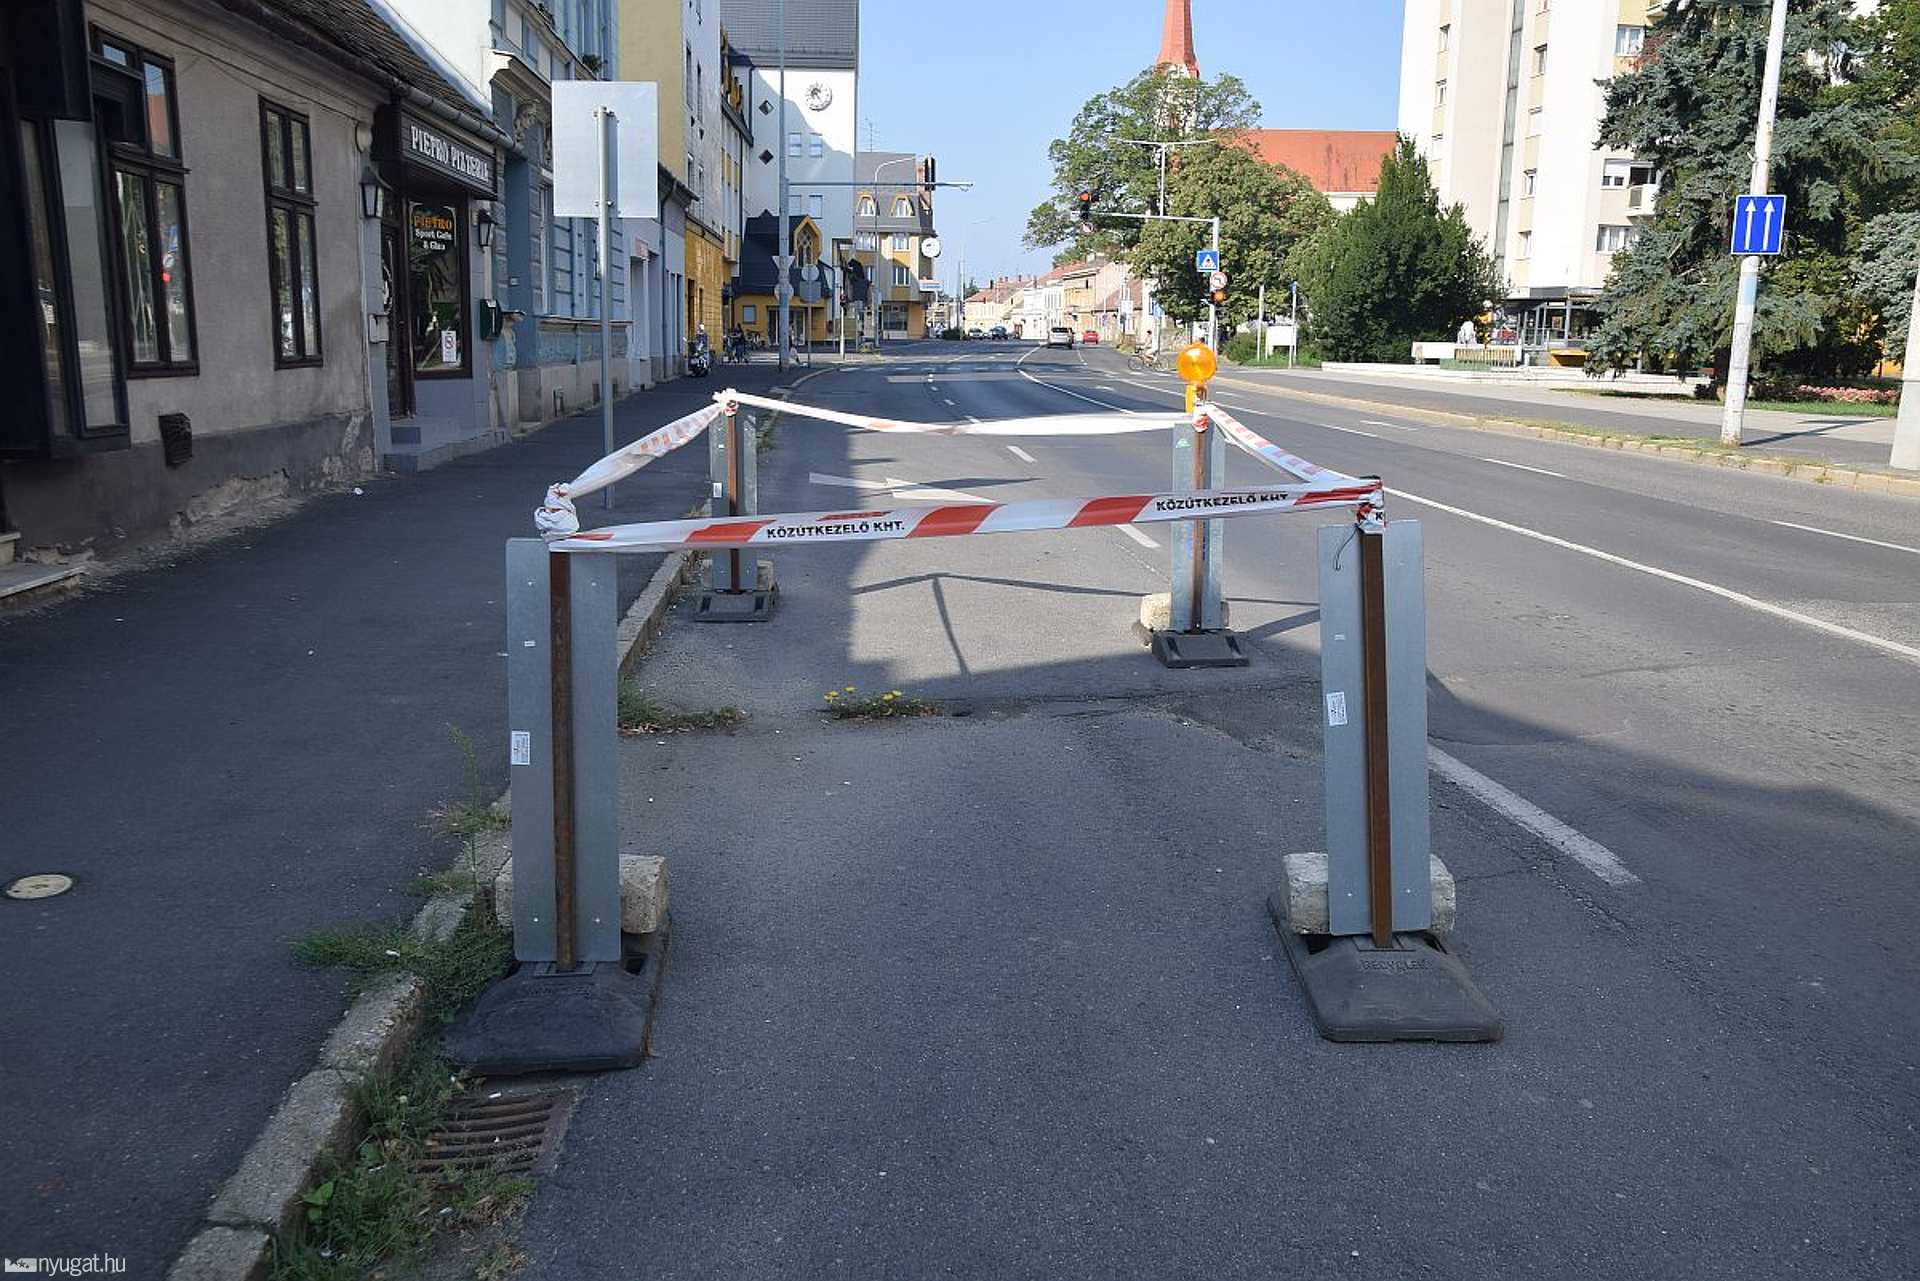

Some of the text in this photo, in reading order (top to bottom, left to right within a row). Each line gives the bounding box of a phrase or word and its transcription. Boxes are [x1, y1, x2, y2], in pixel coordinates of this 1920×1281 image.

[411, 126, 449, 164] PIETRO
[767, 520, 905, 539] KÖZÚTKEZELŐ KHT.
